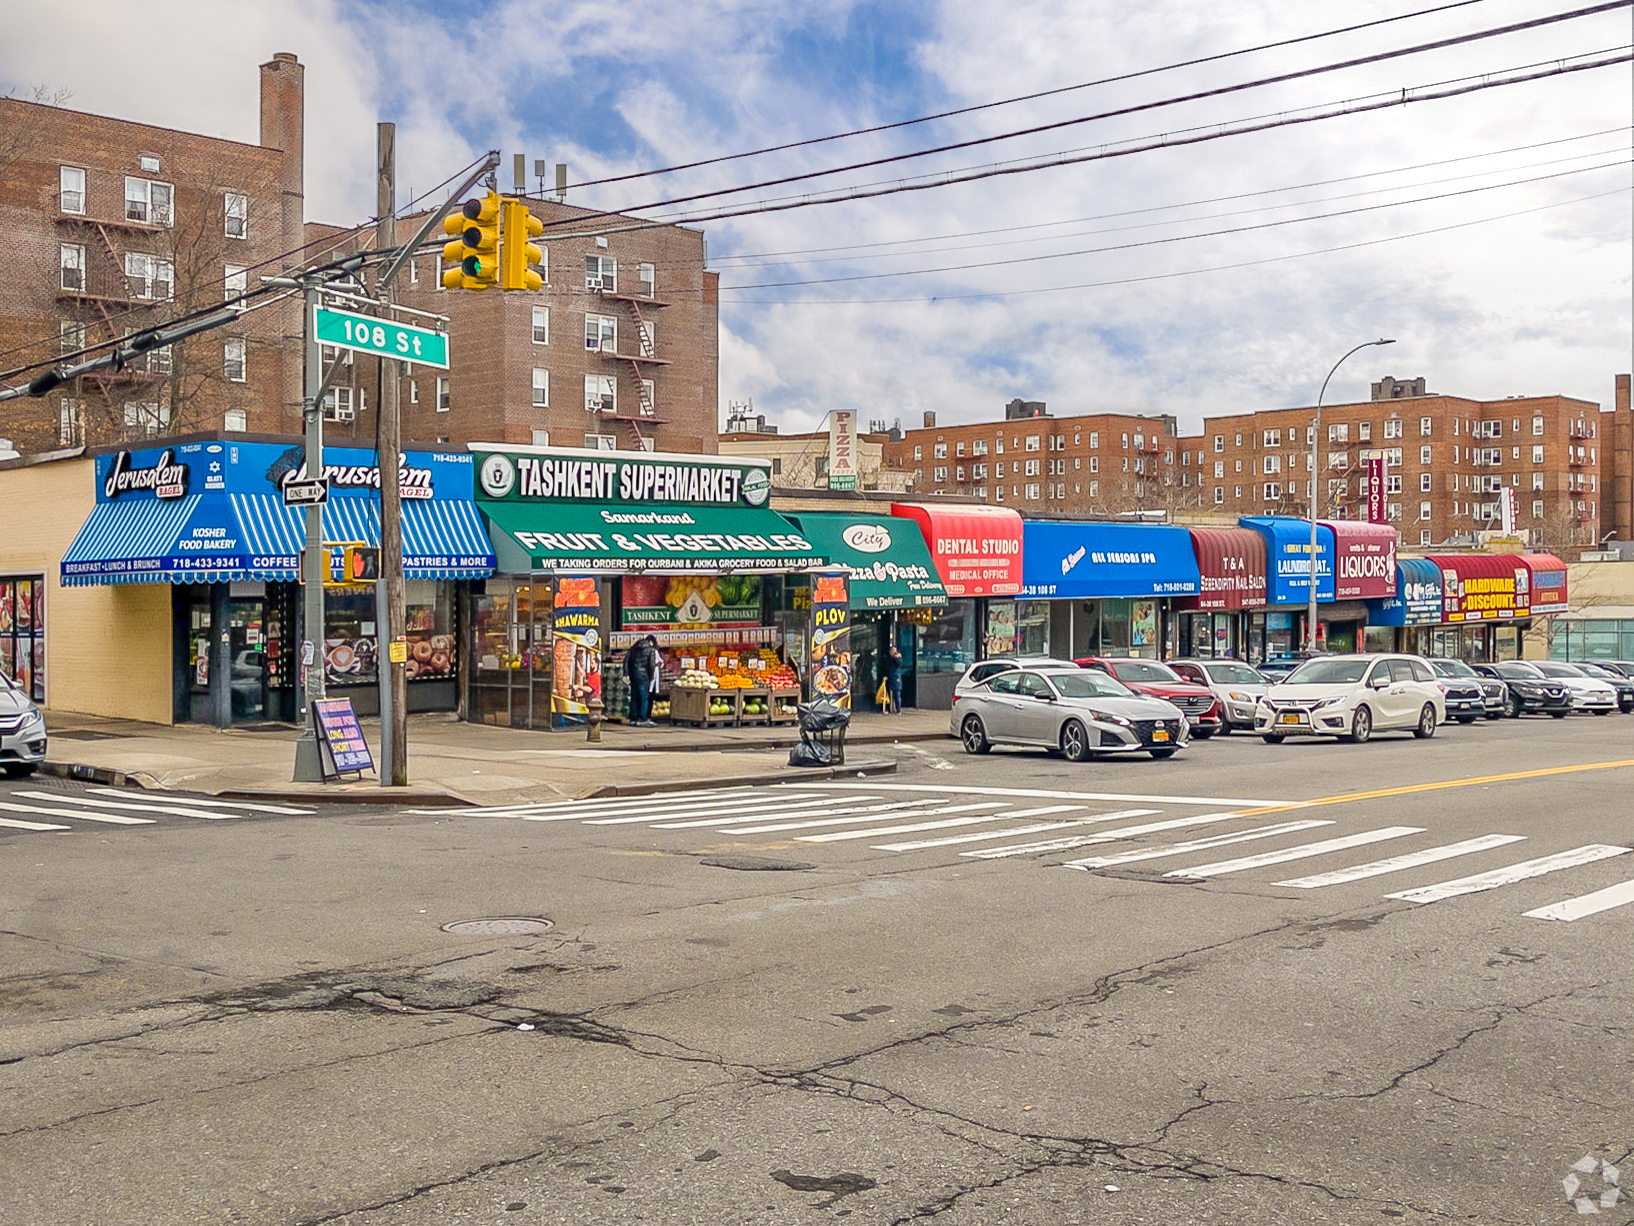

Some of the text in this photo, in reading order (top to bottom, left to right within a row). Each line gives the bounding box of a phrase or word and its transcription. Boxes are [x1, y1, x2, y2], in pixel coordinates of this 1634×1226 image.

[345, 320, 421, 356] 108 St
[836, 412, 851, 469] PIZZA
[106, 451, 185, 497] Jerusalem
[517, 458, 741, 502] TASHKENT SUPERMARKET
[159, 485, 182, 495] BAGEL
[290, 487, 321, 498] ONE WAY
[400, 488, 430, 497] AGEL
[1371, 460, 1380, 520] LIQUORS
[600, 511, 695, 524] Samarkand
[193, 528, 227, 538] KOSHER
[179, 539, 237, 550] FOOD BAKERY
[514, 531, 812, 551] FRUIT & VEGETABLES
[851, 531, 883, 549] City
[937, 539, 1019, 554] DENTAL STUDIO
[173, 558, 239, 568] 718-433-9341
[253, 557, 297, 567] COFFEE
[402, 557, 448, 567] PASTRIES
[450, 557, 457, 566] &
[460, 557, 487, 567] MORE
[542, 558, 823, 568] WE TAKING ORDERS FOR QURBANI & AKIKA GROCERY FOOD & SALAD BAR
[1092, 552, 1156, 564] ALL SEASONS SPA
[1223, 557, 1245, 570] T & A
[127, 560, 132, 570] &
[133, 559, 160, 569] BRUNCH
[1341, 555, 1386, 578] LIQUORS
[949, 570, 1009, 580] MEDICAL OFFICE
[1235, 575, 1248, 590] NAIL
[1249, 573, 1266, 589] SALON
[1464, 578, 1516, 593] HARDWARE
[1038, 585, 1048, 595] 108
[1049, 585, 1057, 595] ST
[866, 597, 878, 607] We
[879, 597, 903, 606] Deliver
[555, 613, 600, 628] SHAWARMA
[627, 610, 758, 621] TASHKENT SUPERMARKET
[815, 608, 846, 626] PLOV
[328, 729, 344, 740] LONG
